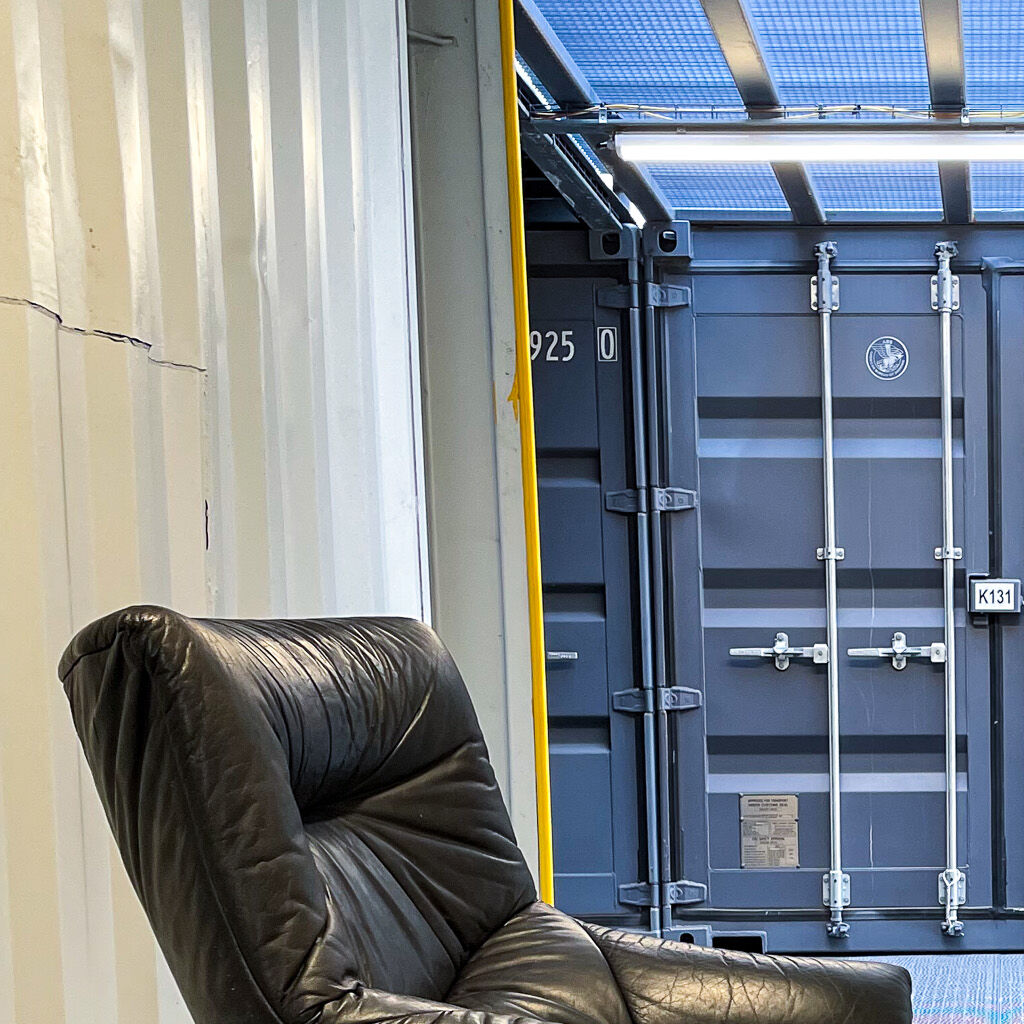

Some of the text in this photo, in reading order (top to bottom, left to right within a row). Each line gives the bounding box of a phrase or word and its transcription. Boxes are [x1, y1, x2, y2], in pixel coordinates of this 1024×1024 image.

[530, 328, 615, 362] 925 0
[978, 588, 1011, 605] K131
